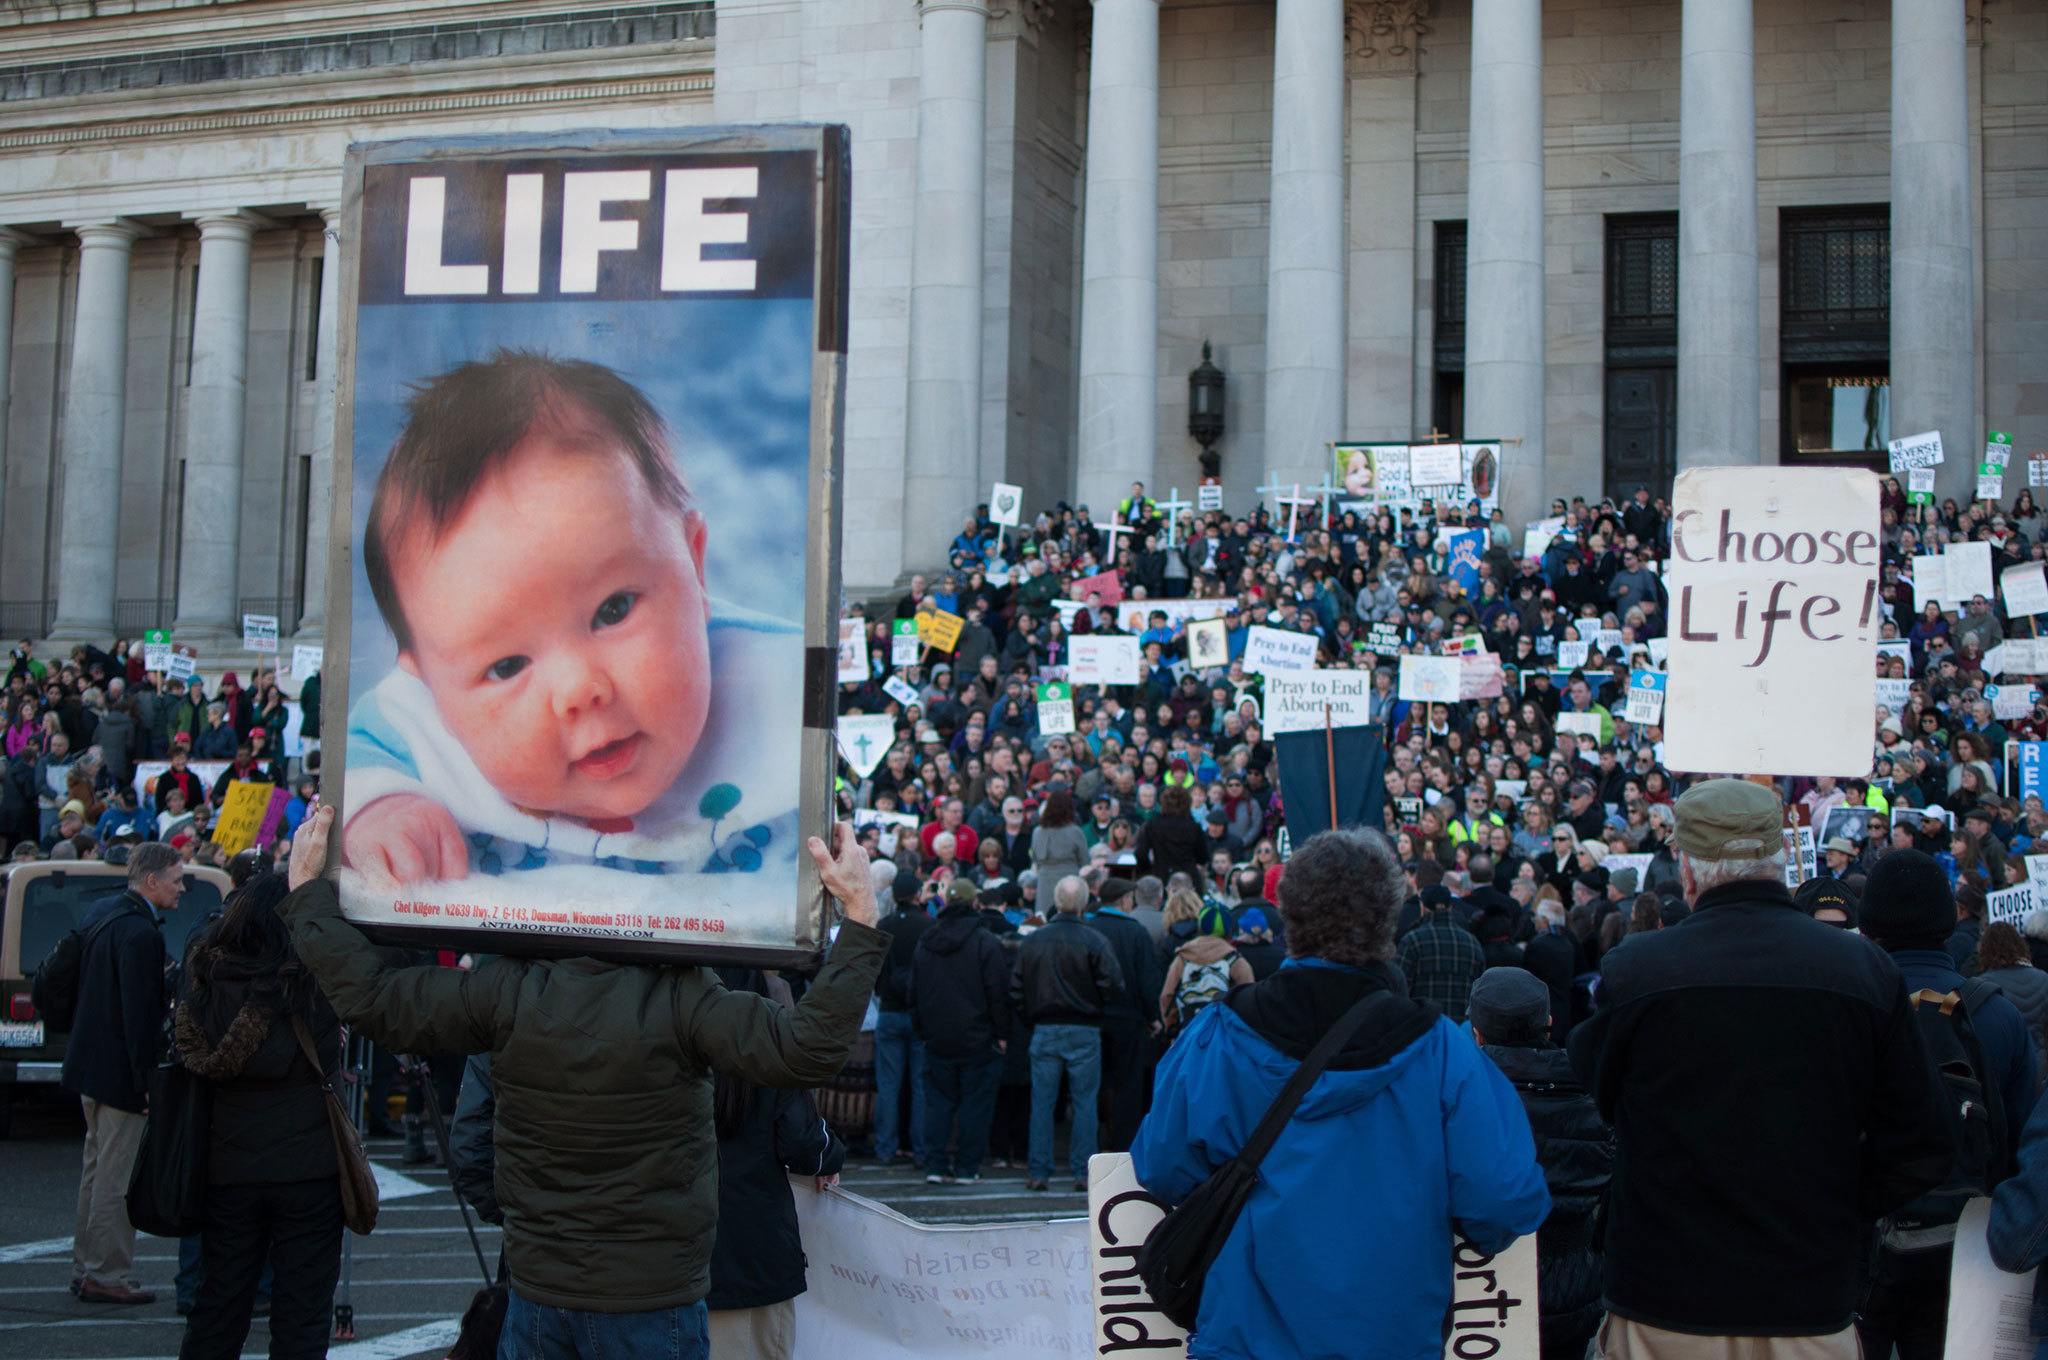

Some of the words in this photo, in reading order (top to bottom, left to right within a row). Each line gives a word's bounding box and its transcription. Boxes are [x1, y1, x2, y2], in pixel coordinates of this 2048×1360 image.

[404, 167, 759, 295] LIFE
[1674, 509, 1876, 566] Choose
[1680, 579, 1876, 667] Life!
[1254, 637, 1275, 652] Pray
[1279, 640, 1290, 651] to
[1291, 643, 1312, 656] End
[1271, 677, 1309, 699] Pray
[1311, 680, 1327, 694] to
[1331, 679, 1363, 696] End
[1630, 690, 1663, 705] DEFEND
[1634, 704, 1652, 718] LIFE
[413, 901, 440, 917] Kilgore
[444, 903, 471, 917] N2639
[492, 906, 499, 919] Z
[573, 911, 613, 926] Wisconsin
[615, 913, 643, 928] 53118
[648, 915, 662, 929] Tel:
[664, 916, 681, 930] 262
[683, 917, 700, 931] 495
[702, 918, 725, 933] 8459
[1992, 889, 2033, 917] CHOOSE
[479, 921, 655, 938] ANTIABORTIONSIGNS.COM
[1452, 1241, 1522, 1360] ortio
